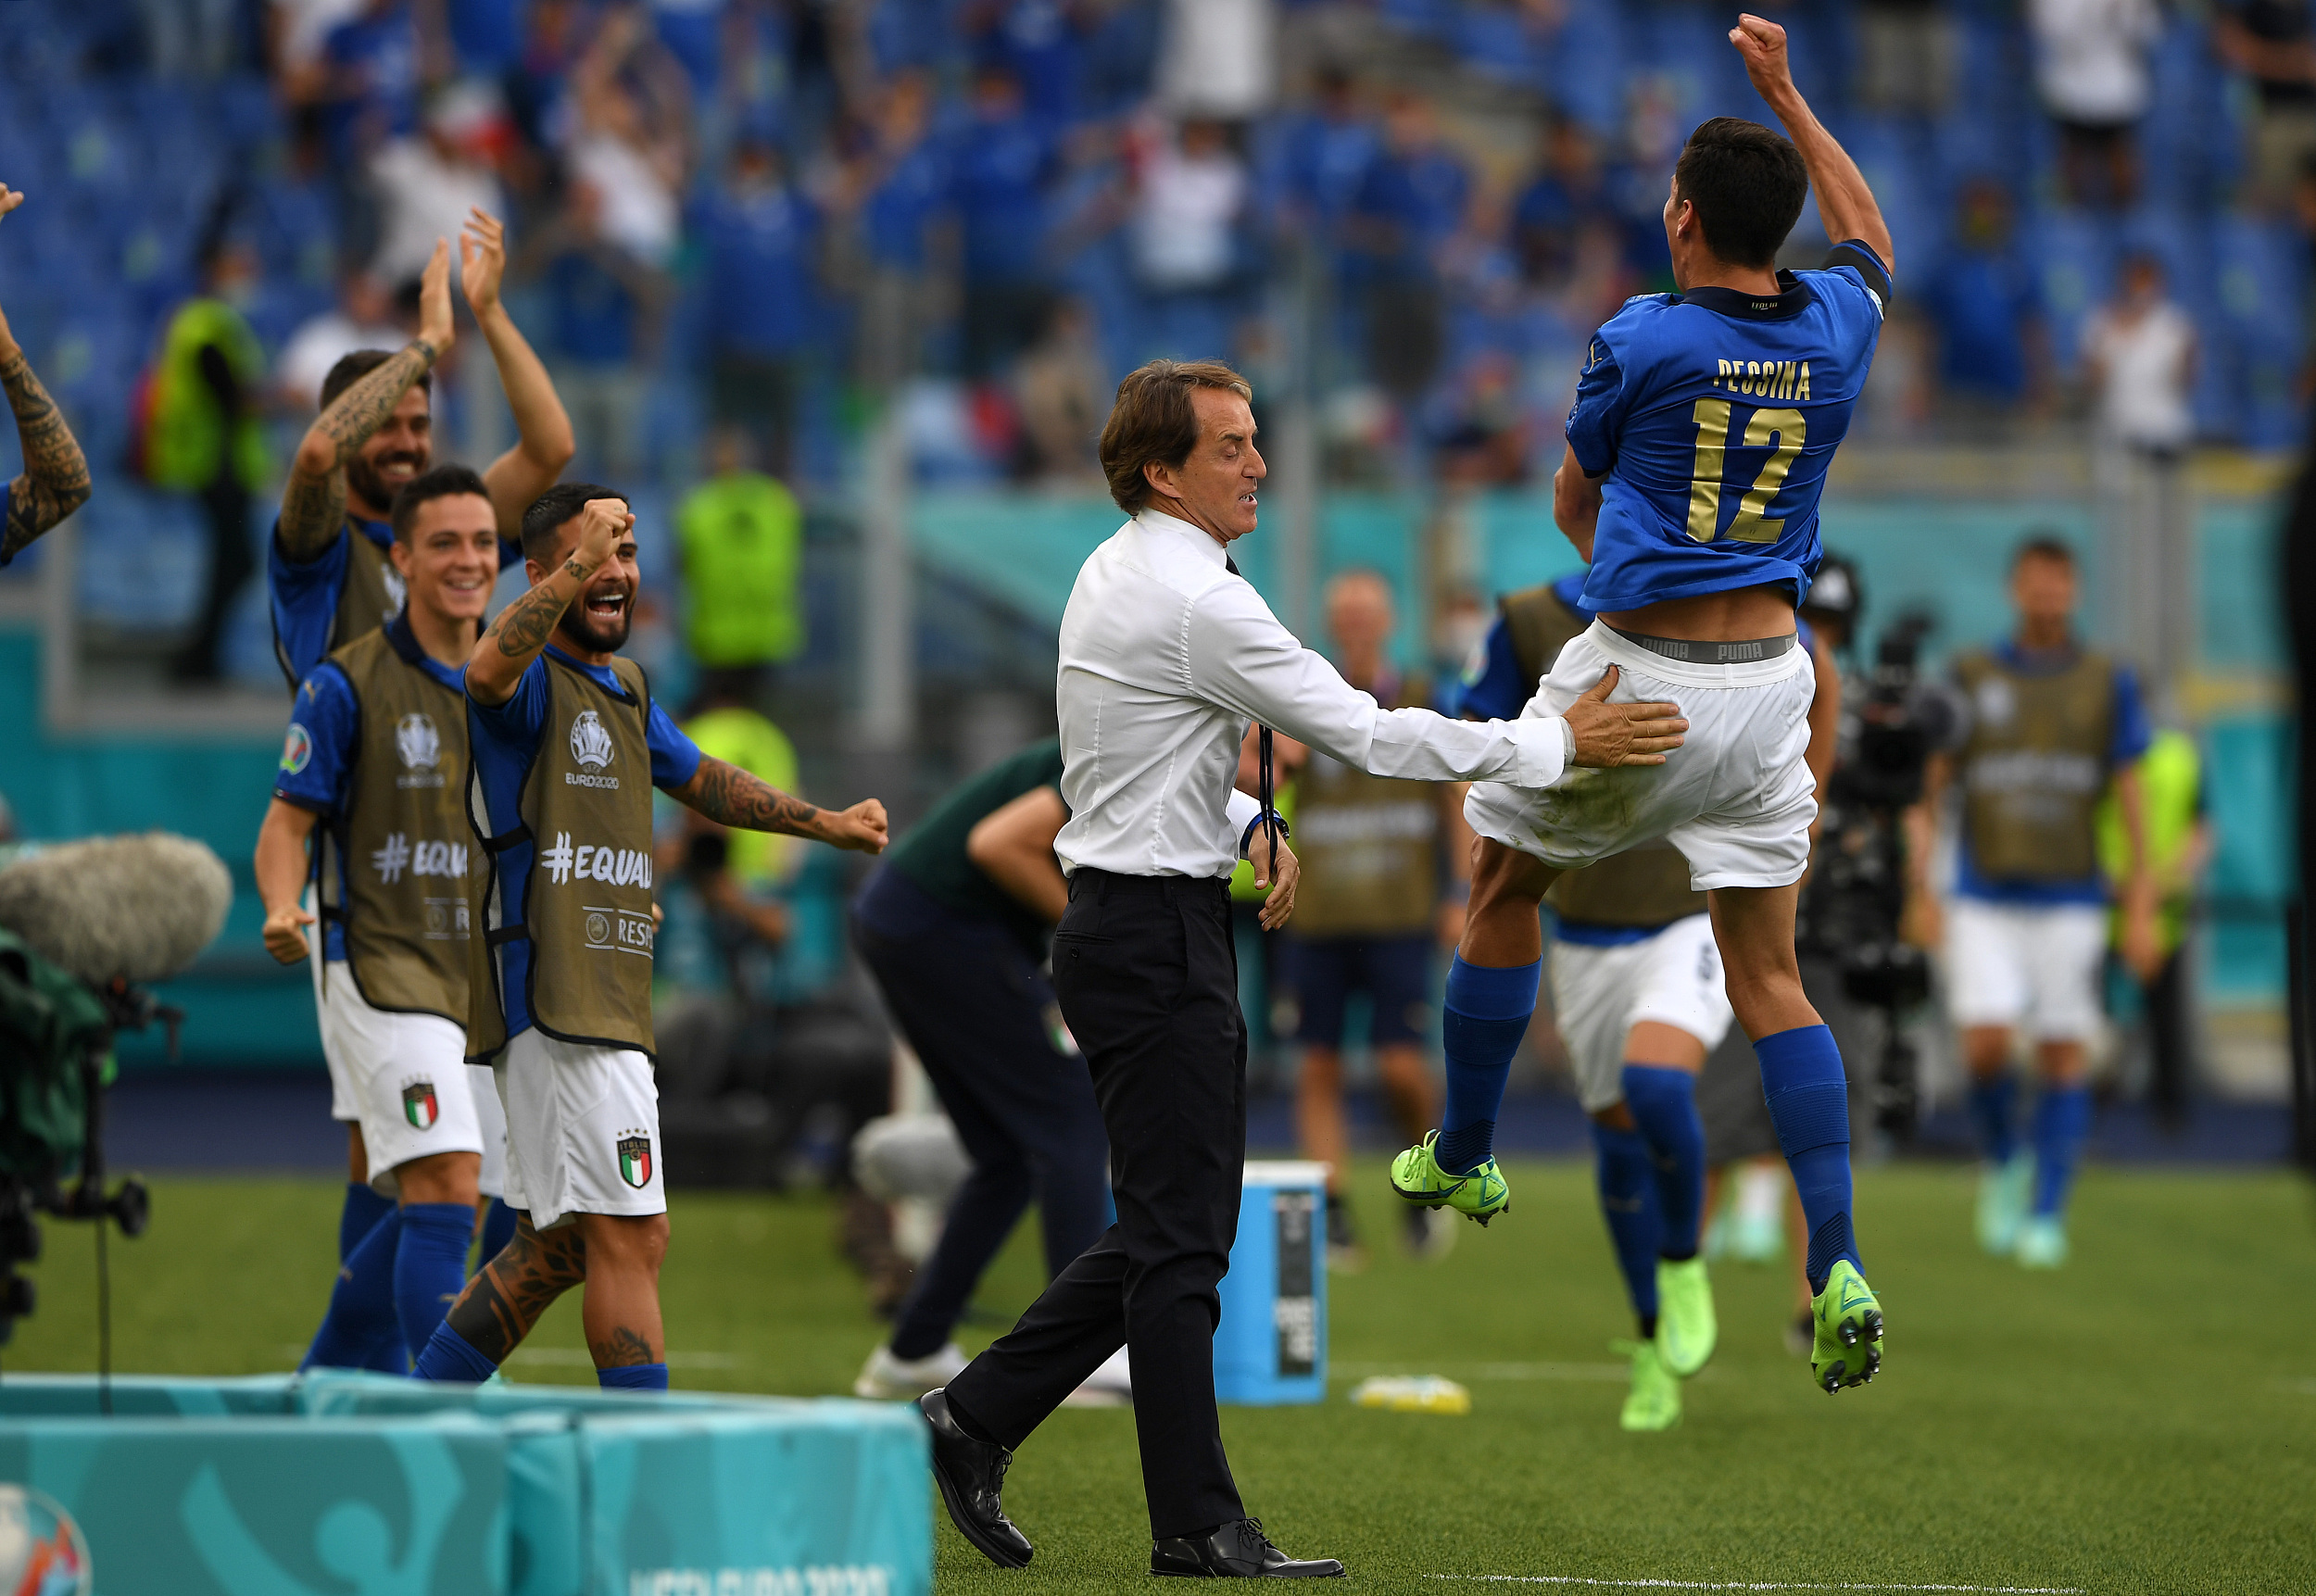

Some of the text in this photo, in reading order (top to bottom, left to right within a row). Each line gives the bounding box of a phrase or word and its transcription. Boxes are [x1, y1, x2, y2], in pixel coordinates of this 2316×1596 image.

[1713, 358, 1810, 401] PESSINA
[1686, 397, 1806, 545] 12
[1718, 642, 1763, 660] PUMA
[565, 772, 620, 790] EURO2020
